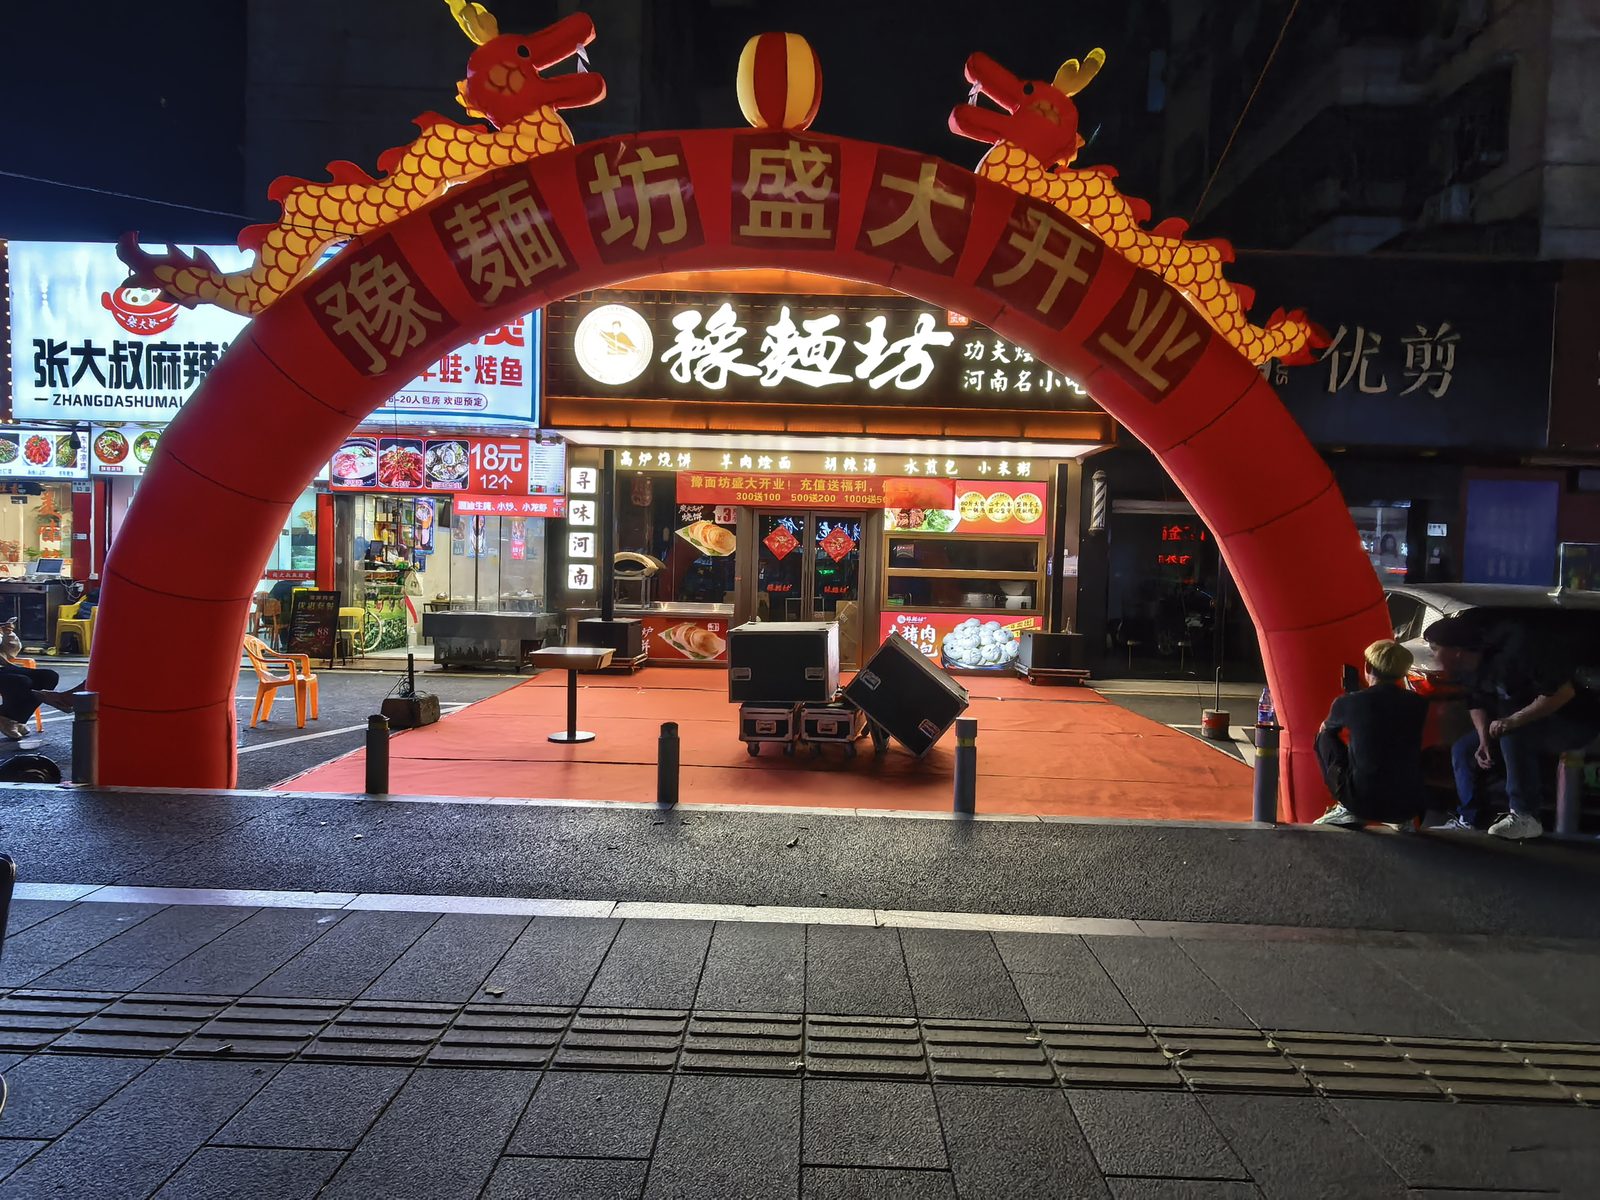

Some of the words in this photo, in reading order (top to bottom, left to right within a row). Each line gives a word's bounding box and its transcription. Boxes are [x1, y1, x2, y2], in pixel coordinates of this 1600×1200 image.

[32, 338, 228, 390] 张大叔麻辣
[1320, 320, 1462, 399] 优剪
[443, 395, 483, 407] 欢迎预定
[470, 443, 523, 473] 18元
[620, 450, 692, 469] 高炉烧饼
[720, 454, 792, 471] 羊肉烩面
[824, 457, 877, 473] 胡辣汤
[903, 460, 959, 475] 水煎包
[977, 463, 1032, 477] 小米粥
[479, 474, 513, 491] 12个
[800, 477, 887, 492] 充值送福利，
[736, 492, 781, 502] 300送100
[791, 494, 836, 503] 500送200
[572, 470, 592, 587] 寻味河南
